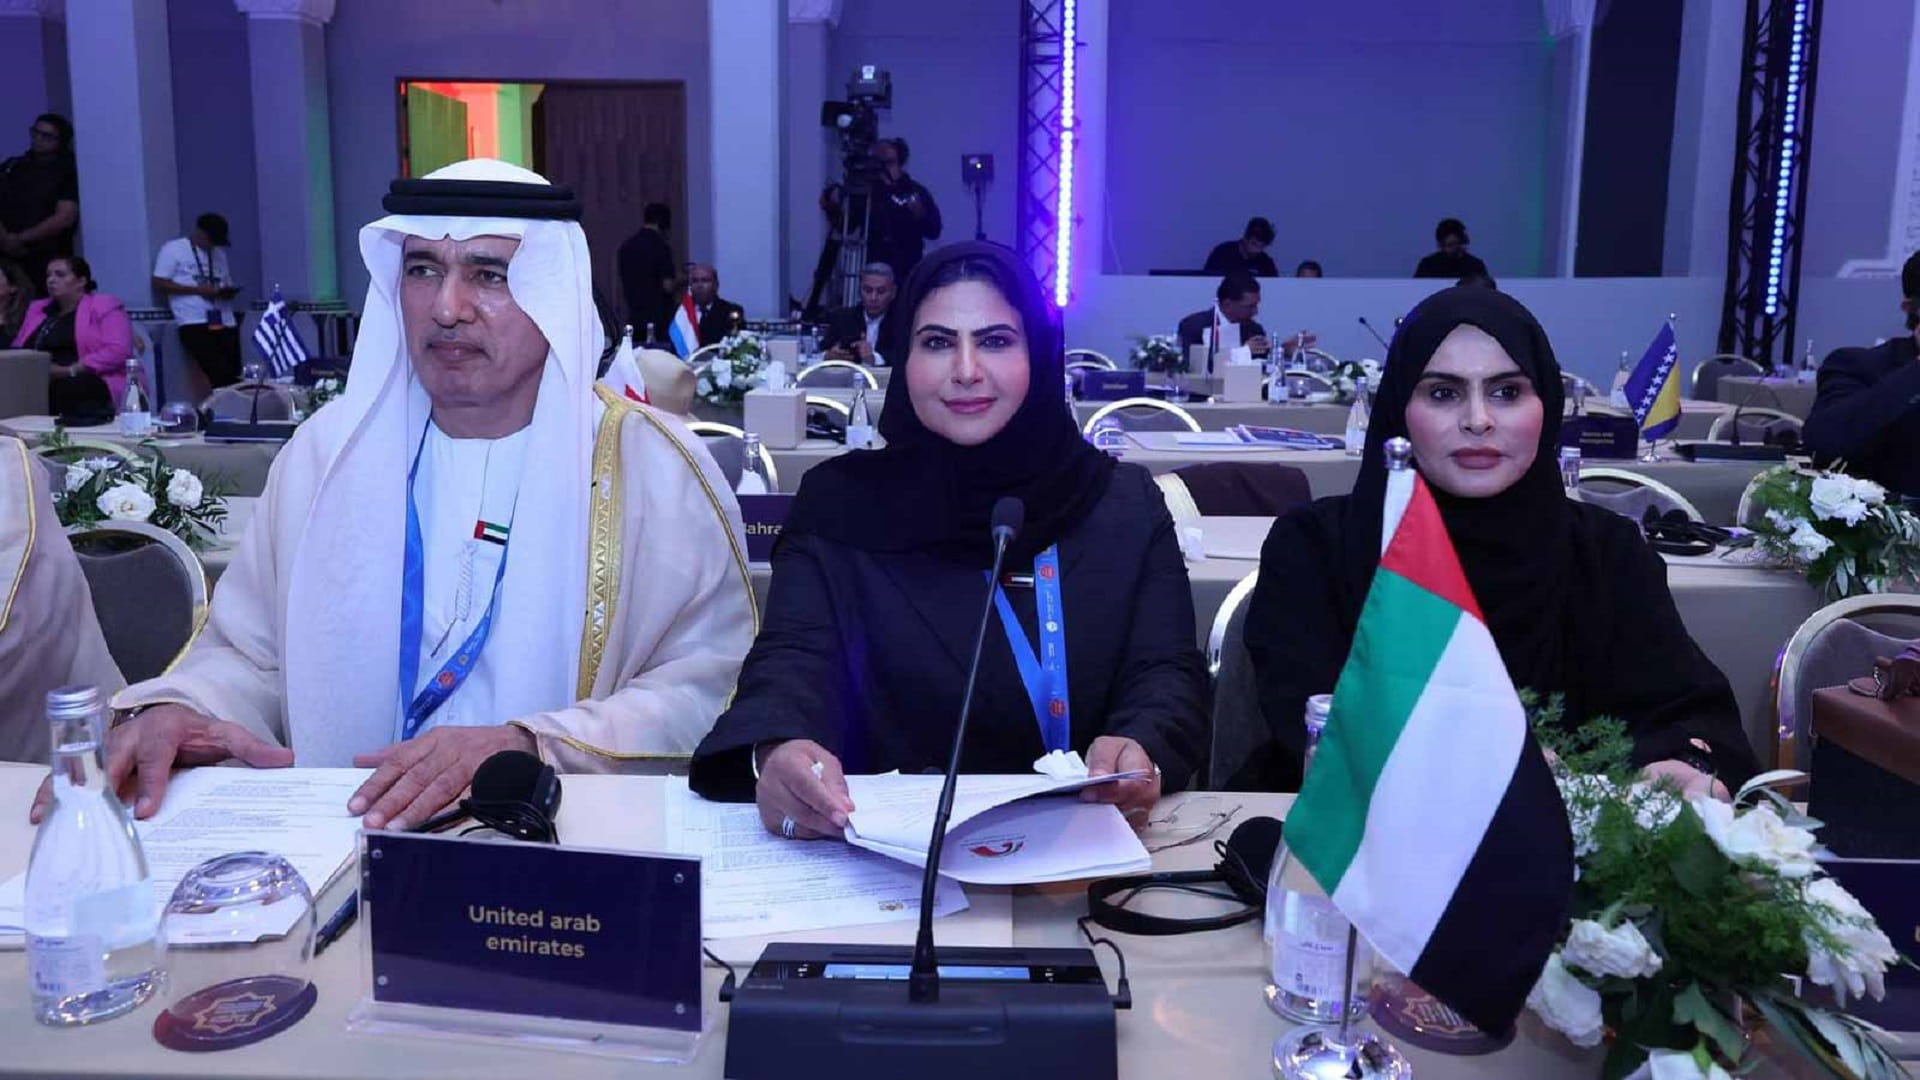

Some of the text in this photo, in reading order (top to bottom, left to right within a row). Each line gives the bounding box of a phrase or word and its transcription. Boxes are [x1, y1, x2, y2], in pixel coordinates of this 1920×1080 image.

[744, 522, 783, 534] ahra
[469, 905, 601, 932] United arab
[486, 935, 585, 958] emirates
